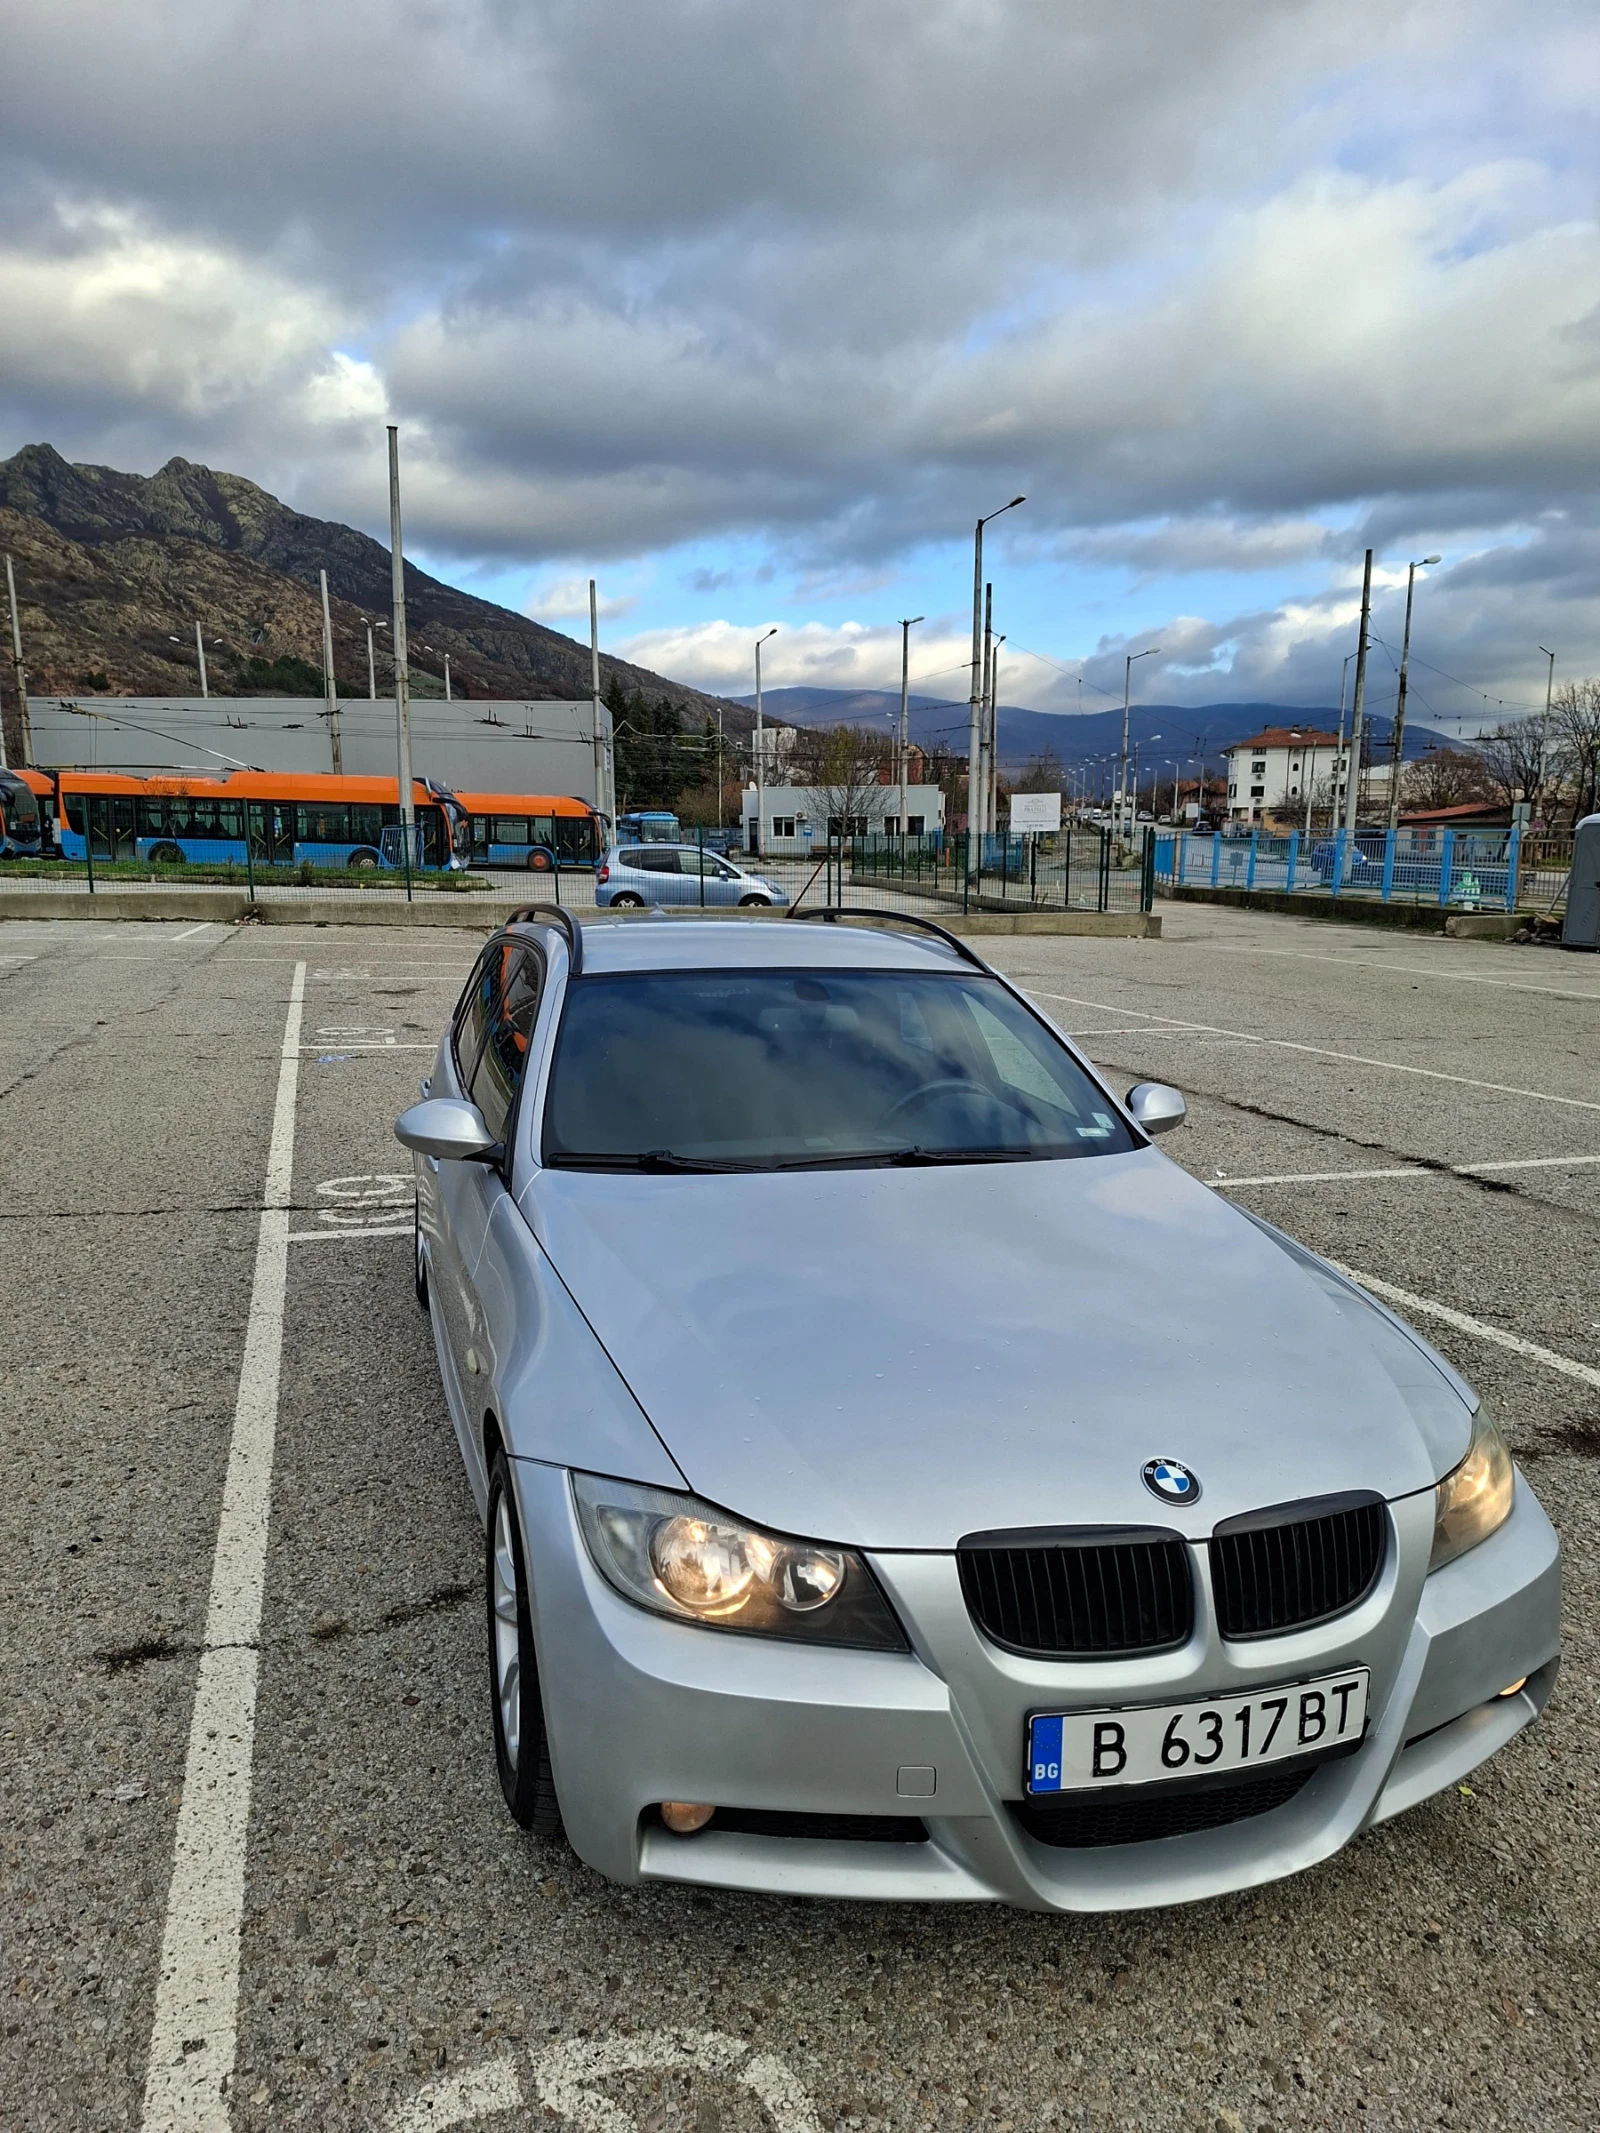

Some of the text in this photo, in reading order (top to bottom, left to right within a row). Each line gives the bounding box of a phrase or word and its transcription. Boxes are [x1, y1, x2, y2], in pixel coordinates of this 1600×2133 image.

[1144, 1459, 1187, 1475] BMW
[1092, 1721, 1127, 1778] B
[1160, 1697, 1289, 1769] 6317
[1034, 1762, 1059, 1780] BG
